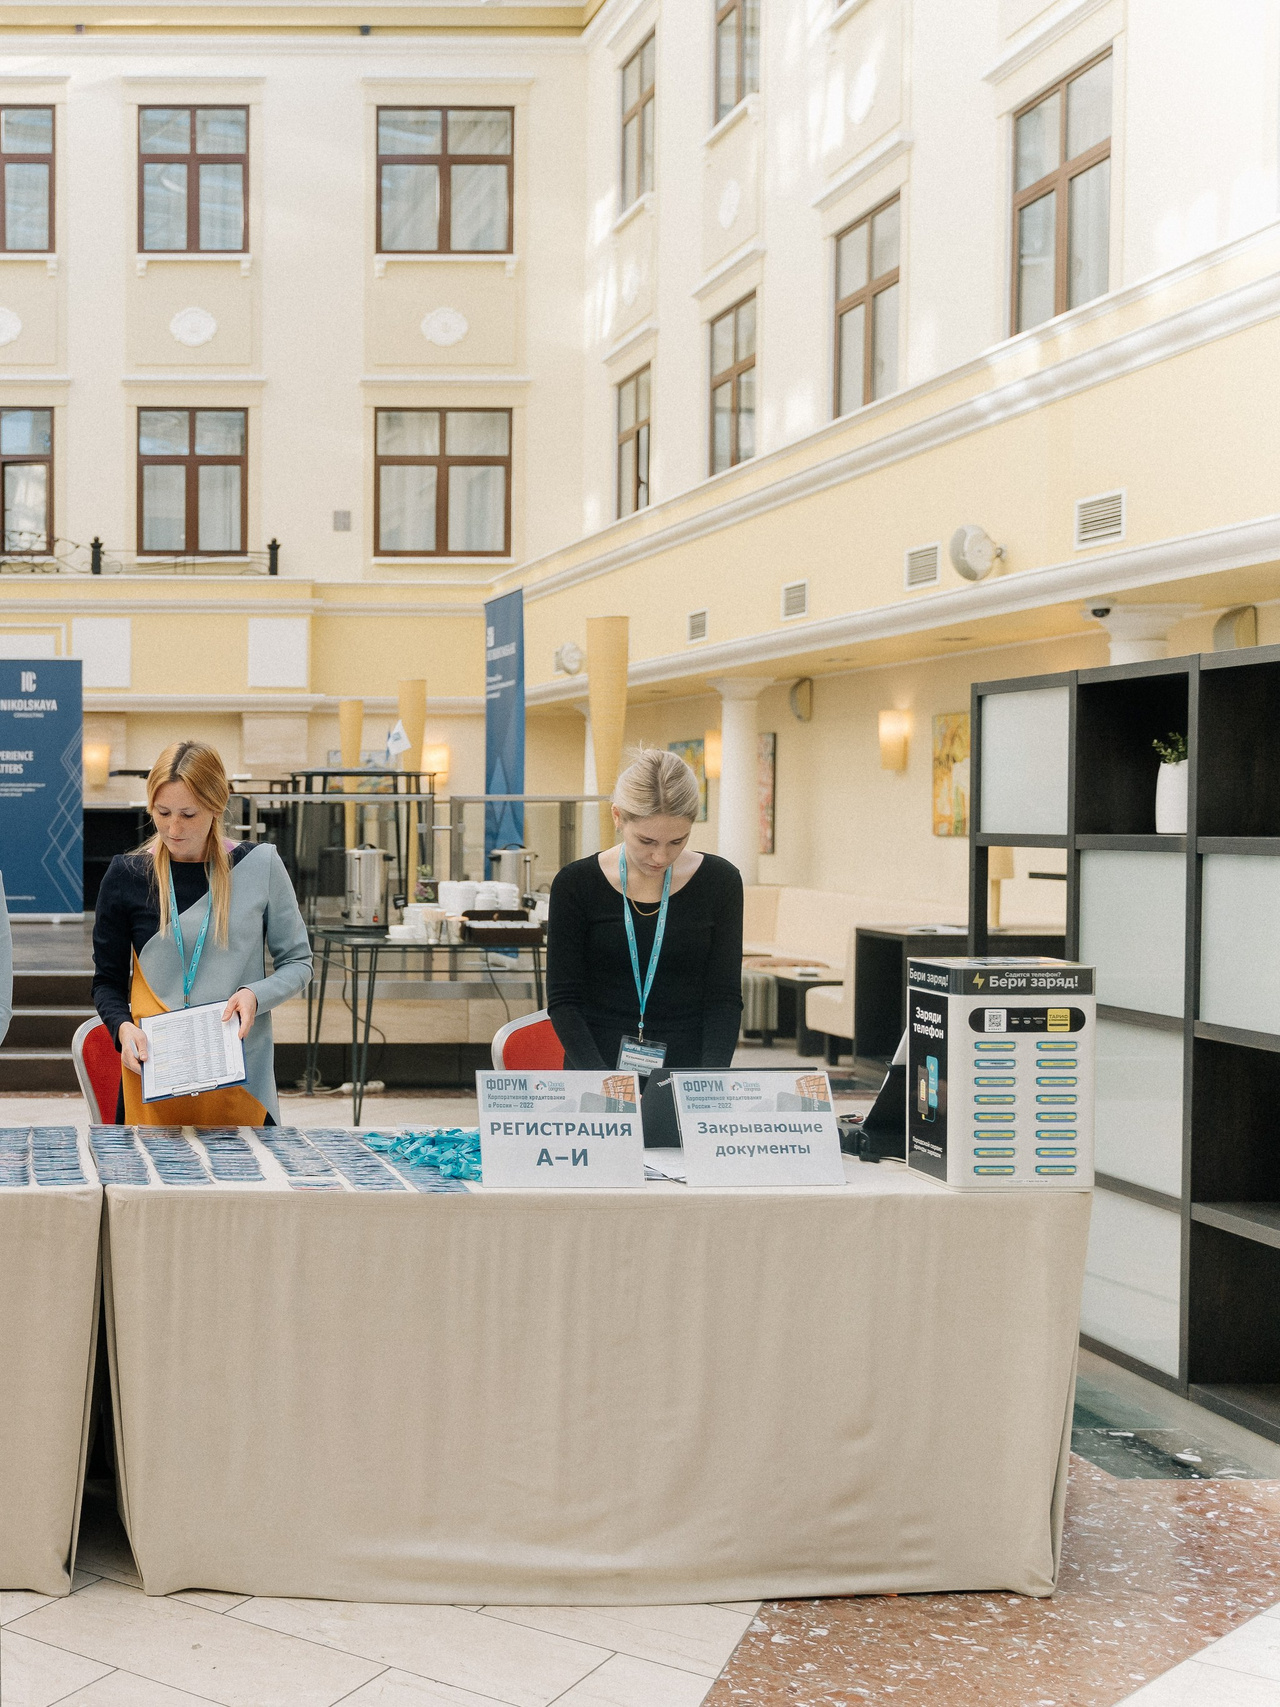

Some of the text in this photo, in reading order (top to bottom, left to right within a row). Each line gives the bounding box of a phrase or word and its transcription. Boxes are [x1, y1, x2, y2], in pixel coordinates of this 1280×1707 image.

[0, 699, 58, 712] NIKOLSKAYA
[909, 967, 949, 988] Бери заряд!
[989, 975, 1079, 990] Бери заряд!
[915, 1006, 942, 1025] Заряди
[913, 1022, 944, 1039] телефон
[486, 1078, 528, 1091] ФОРУМ
[683, 1080, 724, 1093] ФОРУМ
[487, 1093, 528, 1102] Корпоративное
[685, 1094, 725, 1102] Корпоративное
[691, 1102, 711, 1110] России
[490, 1122, 632, 1140] РЕГИСТРАЦИЯ
[697, 1120, 823, 1137] Закрывающие
[536, 1148, 589, 1167] А–И
[715, 1142, 811, 1158] документы
